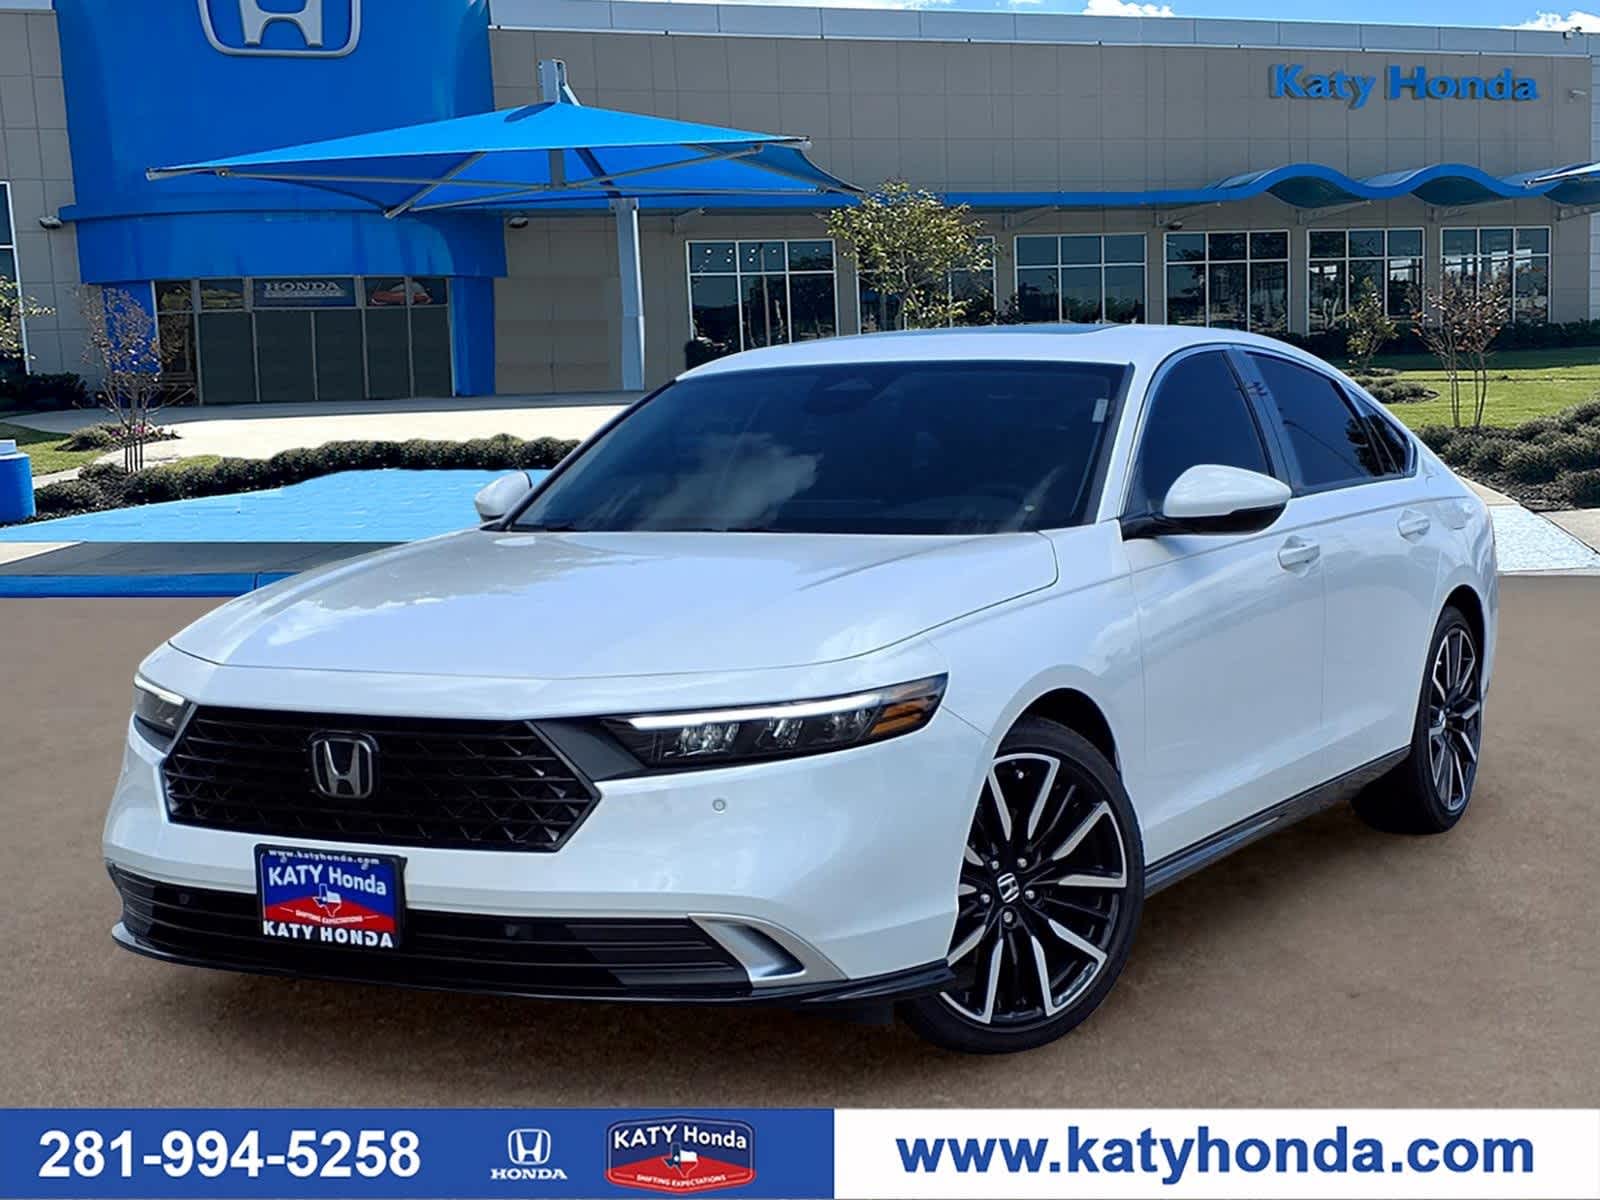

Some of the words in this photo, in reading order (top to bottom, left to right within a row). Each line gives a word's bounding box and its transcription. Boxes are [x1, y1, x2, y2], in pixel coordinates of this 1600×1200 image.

[1271, 64, 1376, 109] Katy
[1386, 65, 1539, 100] Honda
[264, 281, 339, 291] HONDA
[268, 864, 323, 887] KATY
[328, 866, 387, 896] Honda
[263, 920, 314, 940] KATY
[320, 926, 393, 948] HONDA
